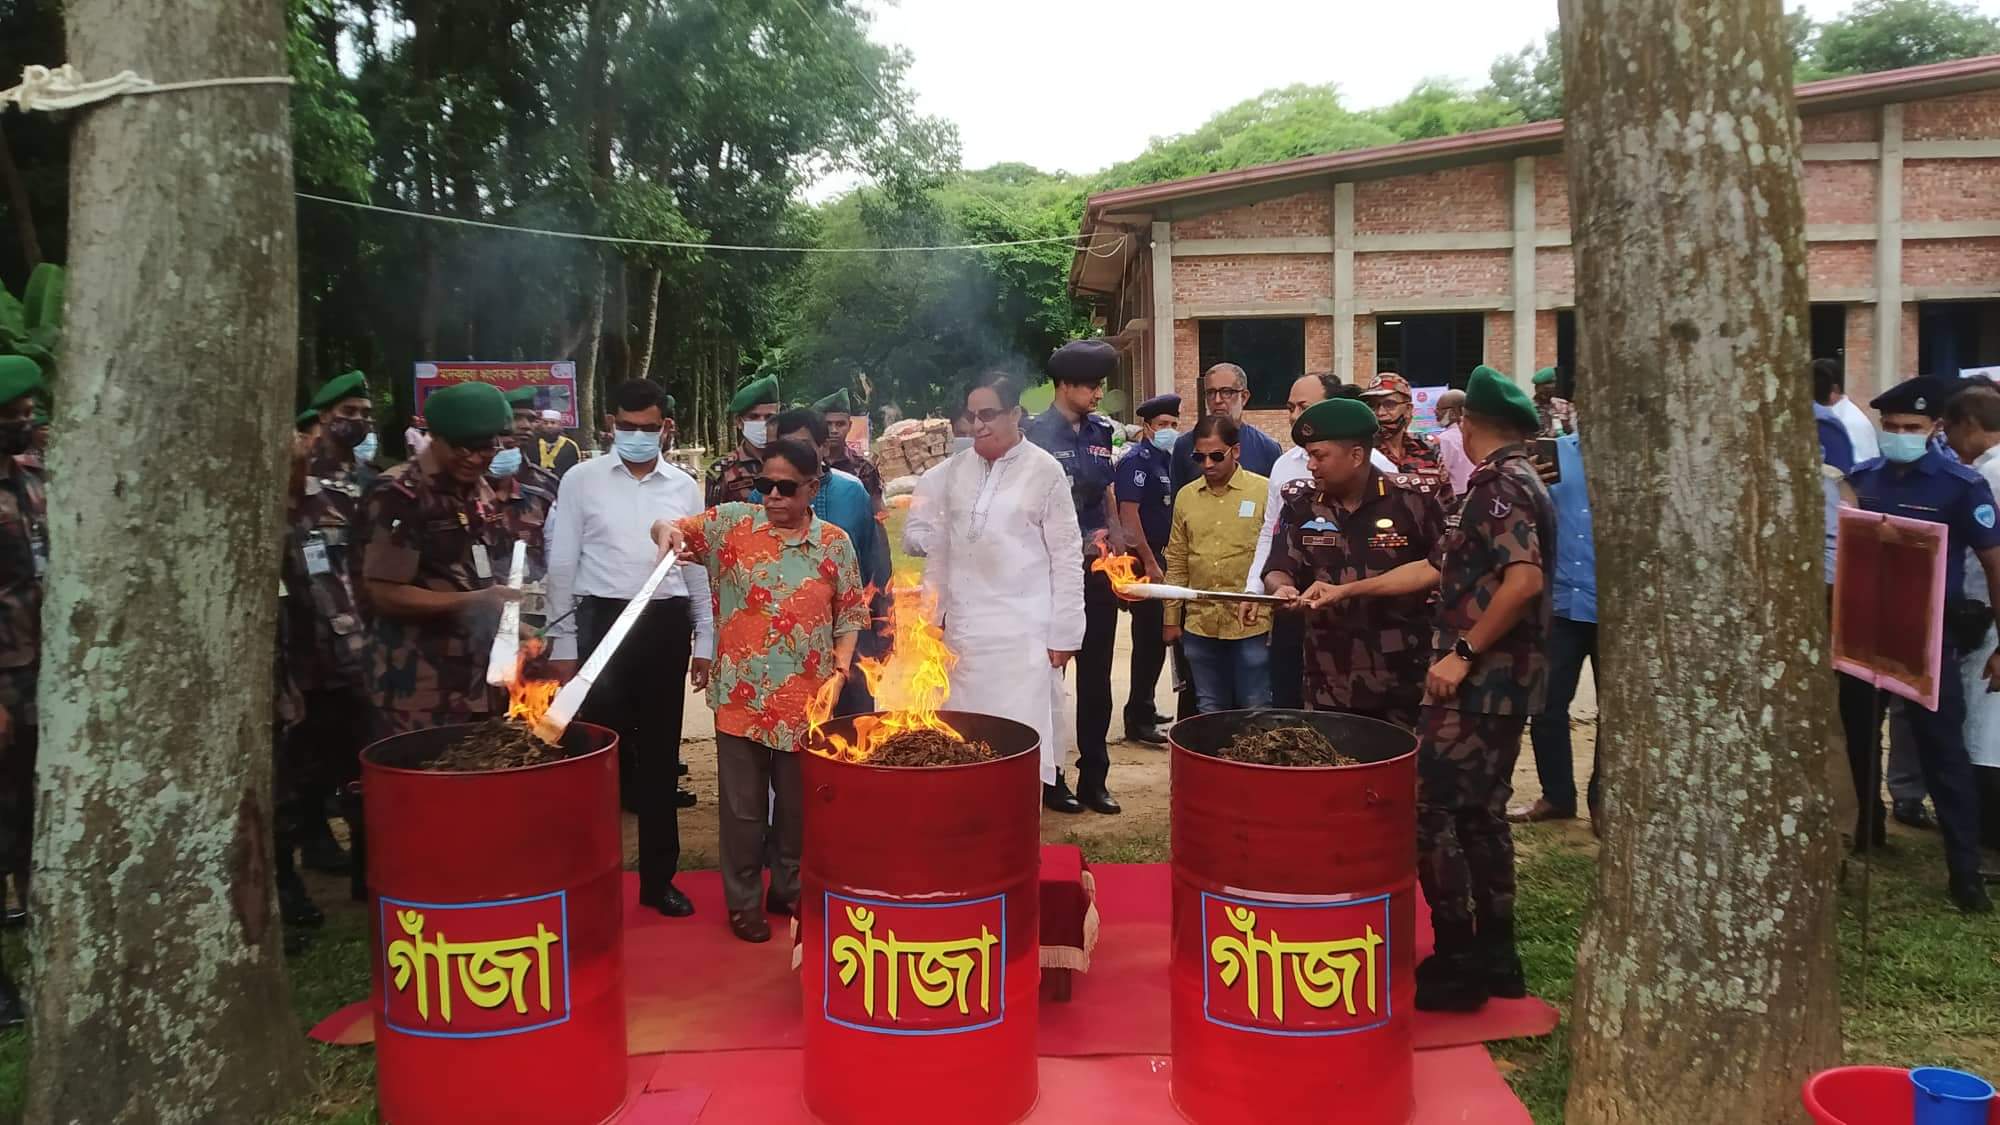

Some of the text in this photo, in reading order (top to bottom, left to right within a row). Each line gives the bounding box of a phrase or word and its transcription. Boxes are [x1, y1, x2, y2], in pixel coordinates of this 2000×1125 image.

[387, 909, 559, 1024] গাঁজা
[832, 906, 999, 1021] গাঁজা
[1211, 906, 1384, 1023] গাঁজা
